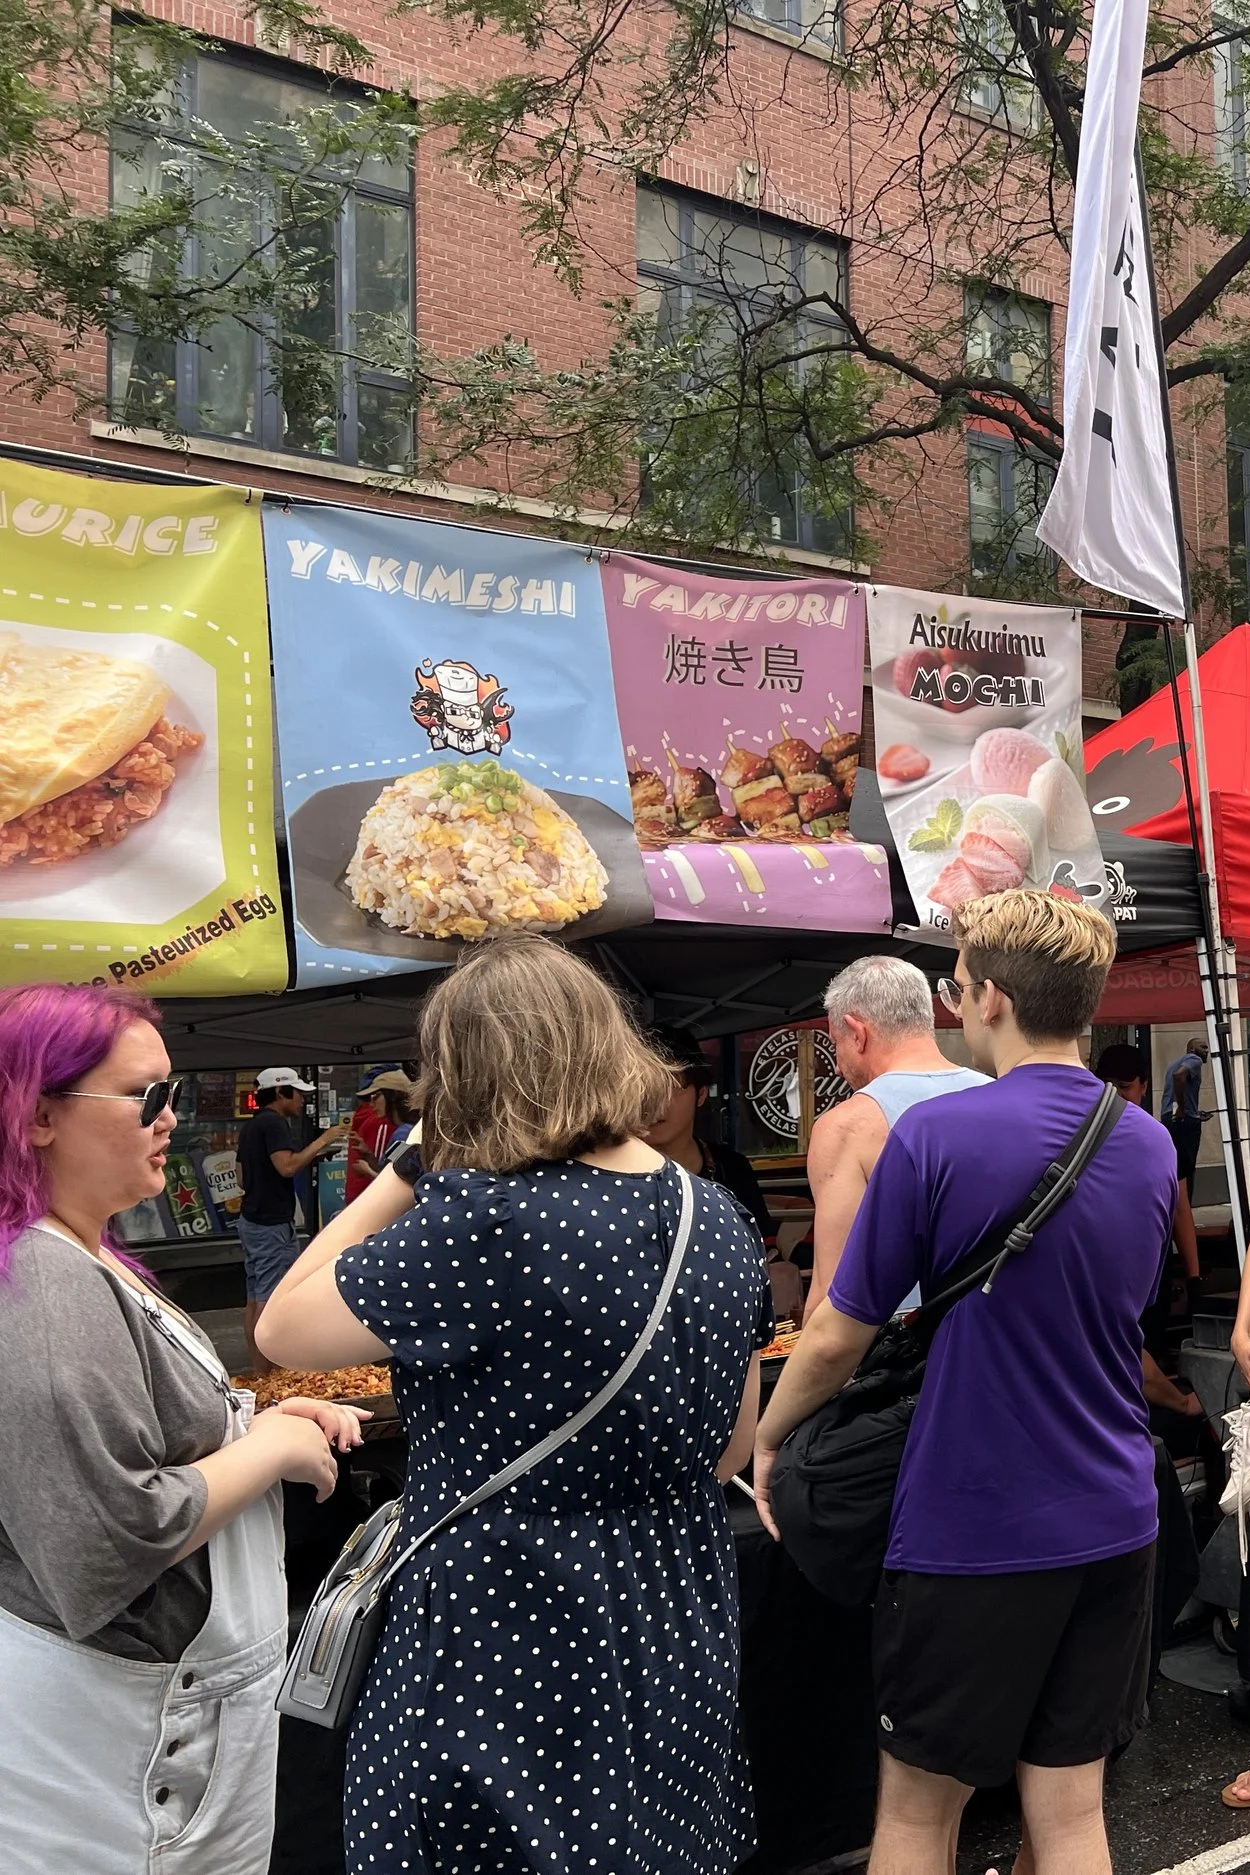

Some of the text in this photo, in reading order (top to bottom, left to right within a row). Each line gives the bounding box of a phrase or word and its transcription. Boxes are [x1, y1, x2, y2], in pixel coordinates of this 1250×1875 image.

[0, 490, 219, 556] URICE
[286, 538, 577, 618] YAKIMESHI
[620, 572, 850, 630] YAKITORI
[909, 612, 1047, 659] Aisukurimu
[663, 632, 806, 694] 焼き鳥
[910, 665, 1046, 708] MOCHI
[928, 908, 949, 931] Ice
[1112, 906, 1137, 921] PAT
[108, 893, 278, 984] Pasteurized Egg
[757, 1031, 798, 1066] EYELAS
[759, 1104, 798, 1133] EYELAS
[206, 1166, 237, 1188] Coro
[216, 1182, 237, 1194] Extr
